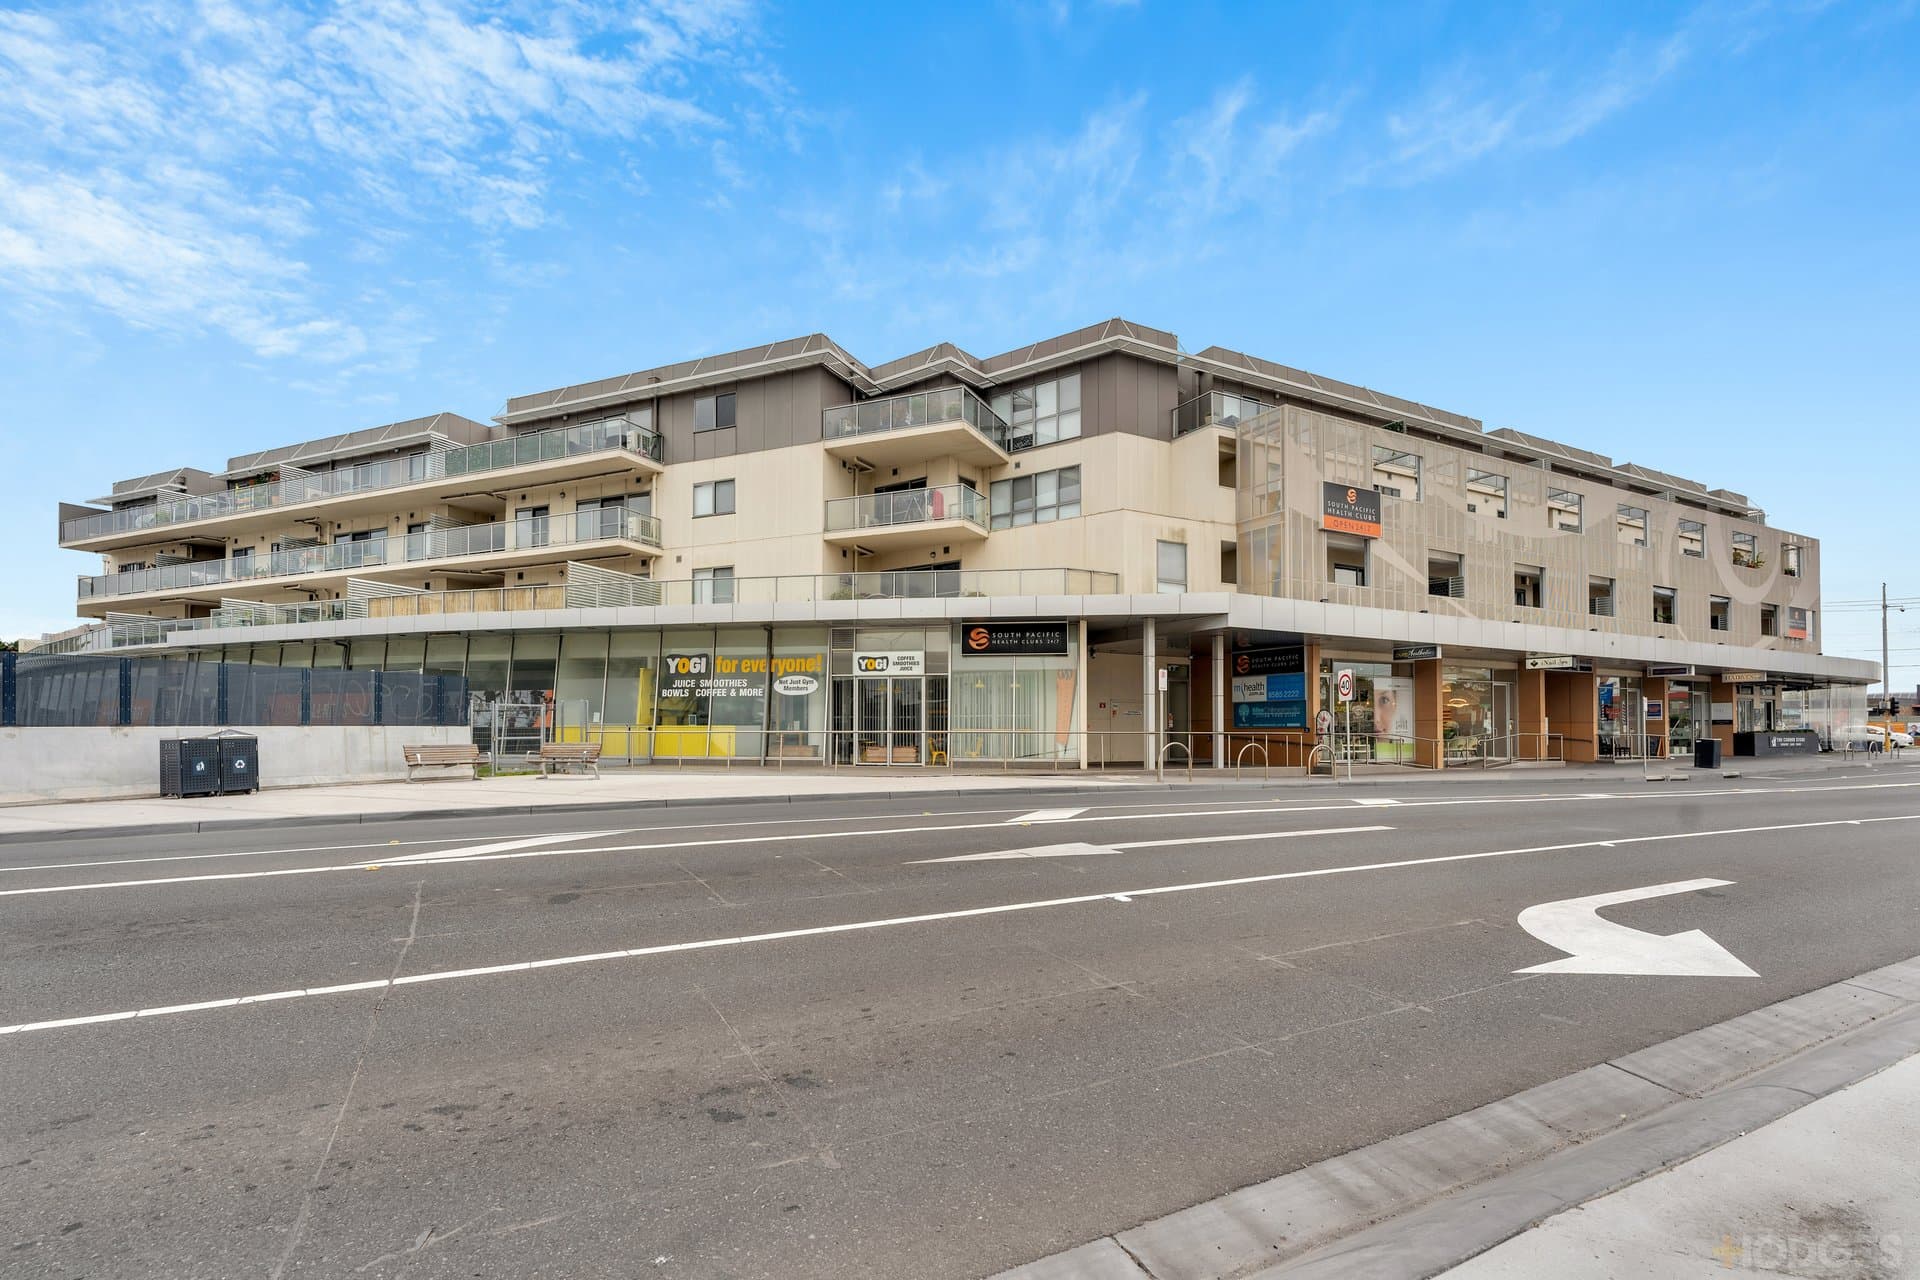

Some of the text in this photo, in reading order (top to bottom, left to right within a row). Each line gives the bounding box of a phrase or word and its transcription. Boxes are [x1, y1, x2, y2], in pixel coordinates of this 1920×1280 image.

[1327, 500, 1376, 514] SOUTH PACIFIC
[1327, 507, 1376, 521] HEALTH CLUBS
[1333, 519, 1354, 529] OPEN
[666, 653, 823, 676] YOGI for everyone!
[858, 658, 888, 670] YOGI
[672, 679, 748, 688] JUICE SMOOTHIES
[1341, 679, 1350, 690] 40
[661, 688, 764, 697] BOWLS COFFEE & MORE
